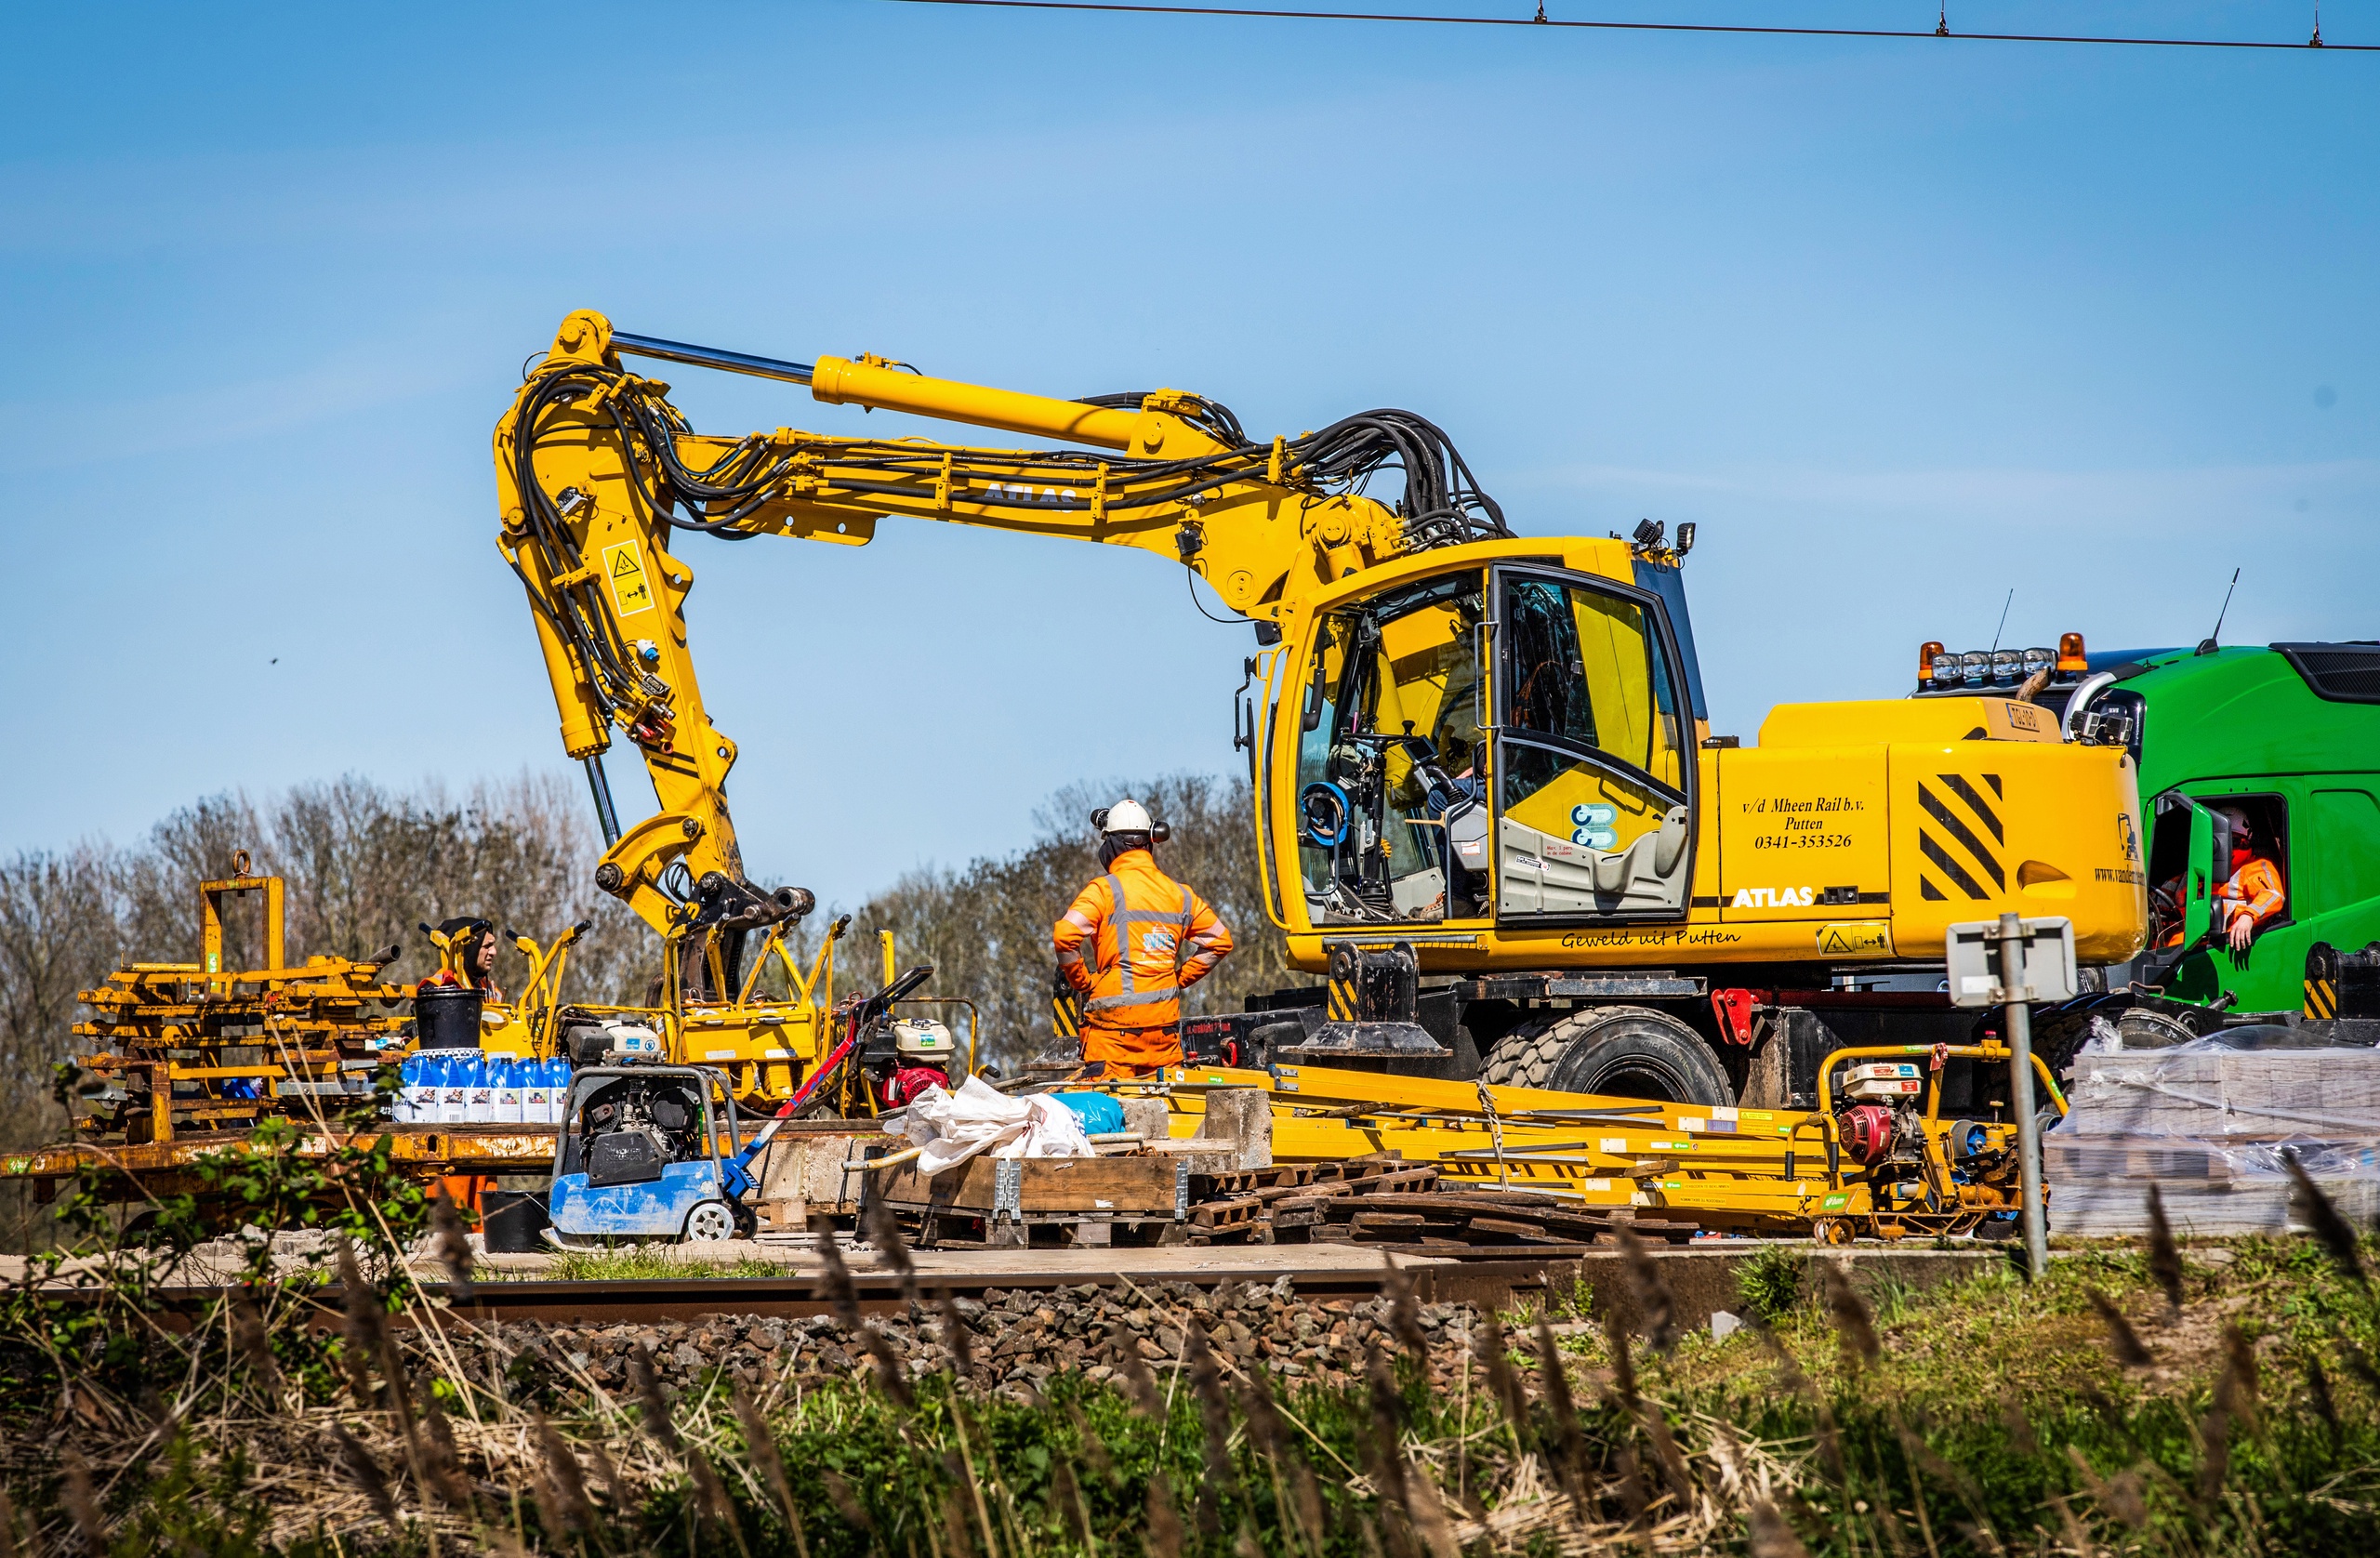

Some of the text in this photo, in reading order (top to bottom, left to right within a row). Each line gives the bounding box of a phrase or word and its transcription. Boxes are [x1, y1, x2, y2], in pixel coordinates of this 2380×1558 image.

[985, 482, 1076, 513] ATLAS
[1742, 797, 1864, 814] v/d Mheen Rail b.v.
[1784, 816, 1823, 830] Putten
[1754, 834, 1853, 849] 0341-353526
[1732, 886, 1814, 908] ATLAS
[1561, 929, 1741, 947] Geweld uit Putten
